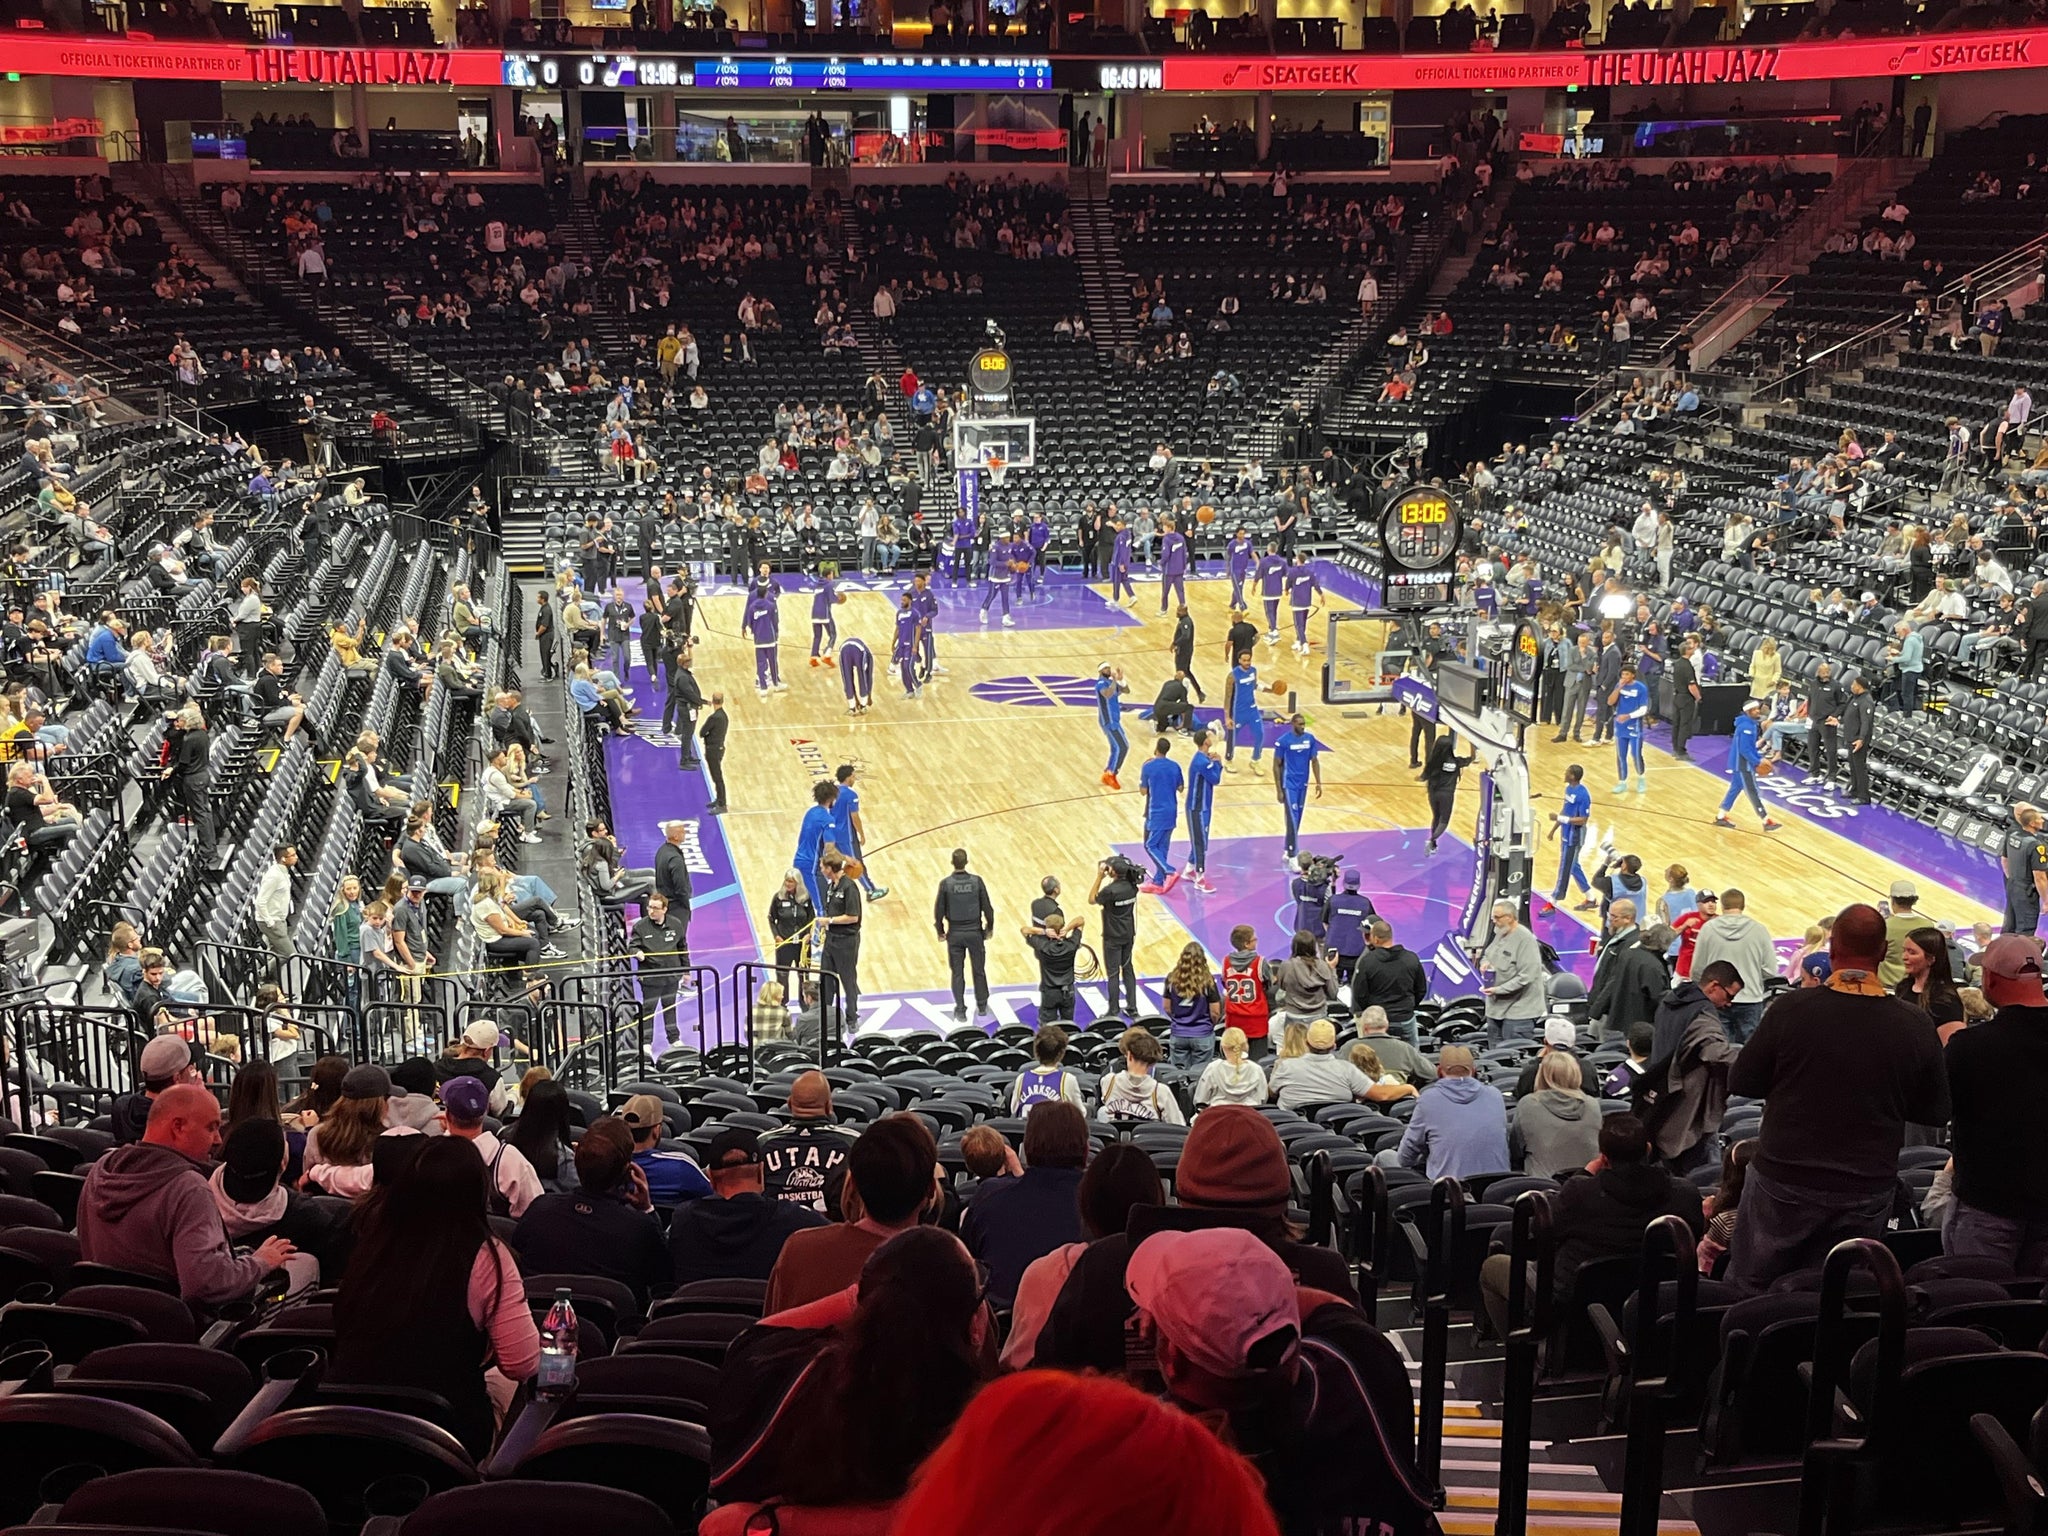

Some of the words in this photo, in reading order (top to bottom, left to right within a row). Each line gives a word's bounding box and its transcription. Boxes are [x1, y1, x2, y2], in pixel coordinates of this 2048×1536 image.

[1930, 38, 2030, 68] SEATGEEK
[60, 52, 111, 67] OFFICIAL
[113, 54, 173, 69] TICKETING
[175, 57, 225, 70] PARTNER
[227, 59, 241, 71] OF
[245, 49, 298, 83] THE
[301, 50, 377, 84] UTAH
[384, 51, 453, 85] JAZZ
[543, 61, 558, 84] 0
[580, 62, 594, 85] 0
[639, 63, 677, 85] 13:06
[679, 74, 694, 85] 1ST
[721, 66, 739, 75] (0%)
[775, 66, 793, 75] (0%)
[828, 66, 846, 75] (0%)
[1018, 68, 1025, 77] 0
[1036, 68, 1043, 77] 0
[1415, 67, 1460, 80] OFFICIAL
[1463, 66, 1516, 80] TICKETING
[1519, 66, 1559, 78] PARTNER
[1562, 65, 1580, 77] OF
[1584, 53, 1632, 86] THE
[1634, 51, 1702, 85] UTAH
[1712, 48, 1780, 83] JAZZ
[721, 77, 739, 86] (0%)
[775, 77, 793, 86] (0%)
[828, 77, 846, 86] (0%)
[1101, 67, 1138, 89] 06:49
[1139, 68, 1162, 89] PM
[1263, 64, 1359, 85] SEATGEEK
[1018, 79, 1025, 88] 0
[1036, 79, 1043, 88] 0
[980, 356, 1006, 370] 13:06
[1402, 502, 1447, 524] 13:06
[1406, 573, 1452, 585] TISSOT
[797, 747, 830, 777] DELTA
[953, 884, 972, 893] POLICE
[1463, 859, 1483, 930] AMERICA
[1227, 978, 1257, 1003] 23
[766, 1147, 845, 1171] UTAH
[778, 1190, 825, 1202] BASKETBA
